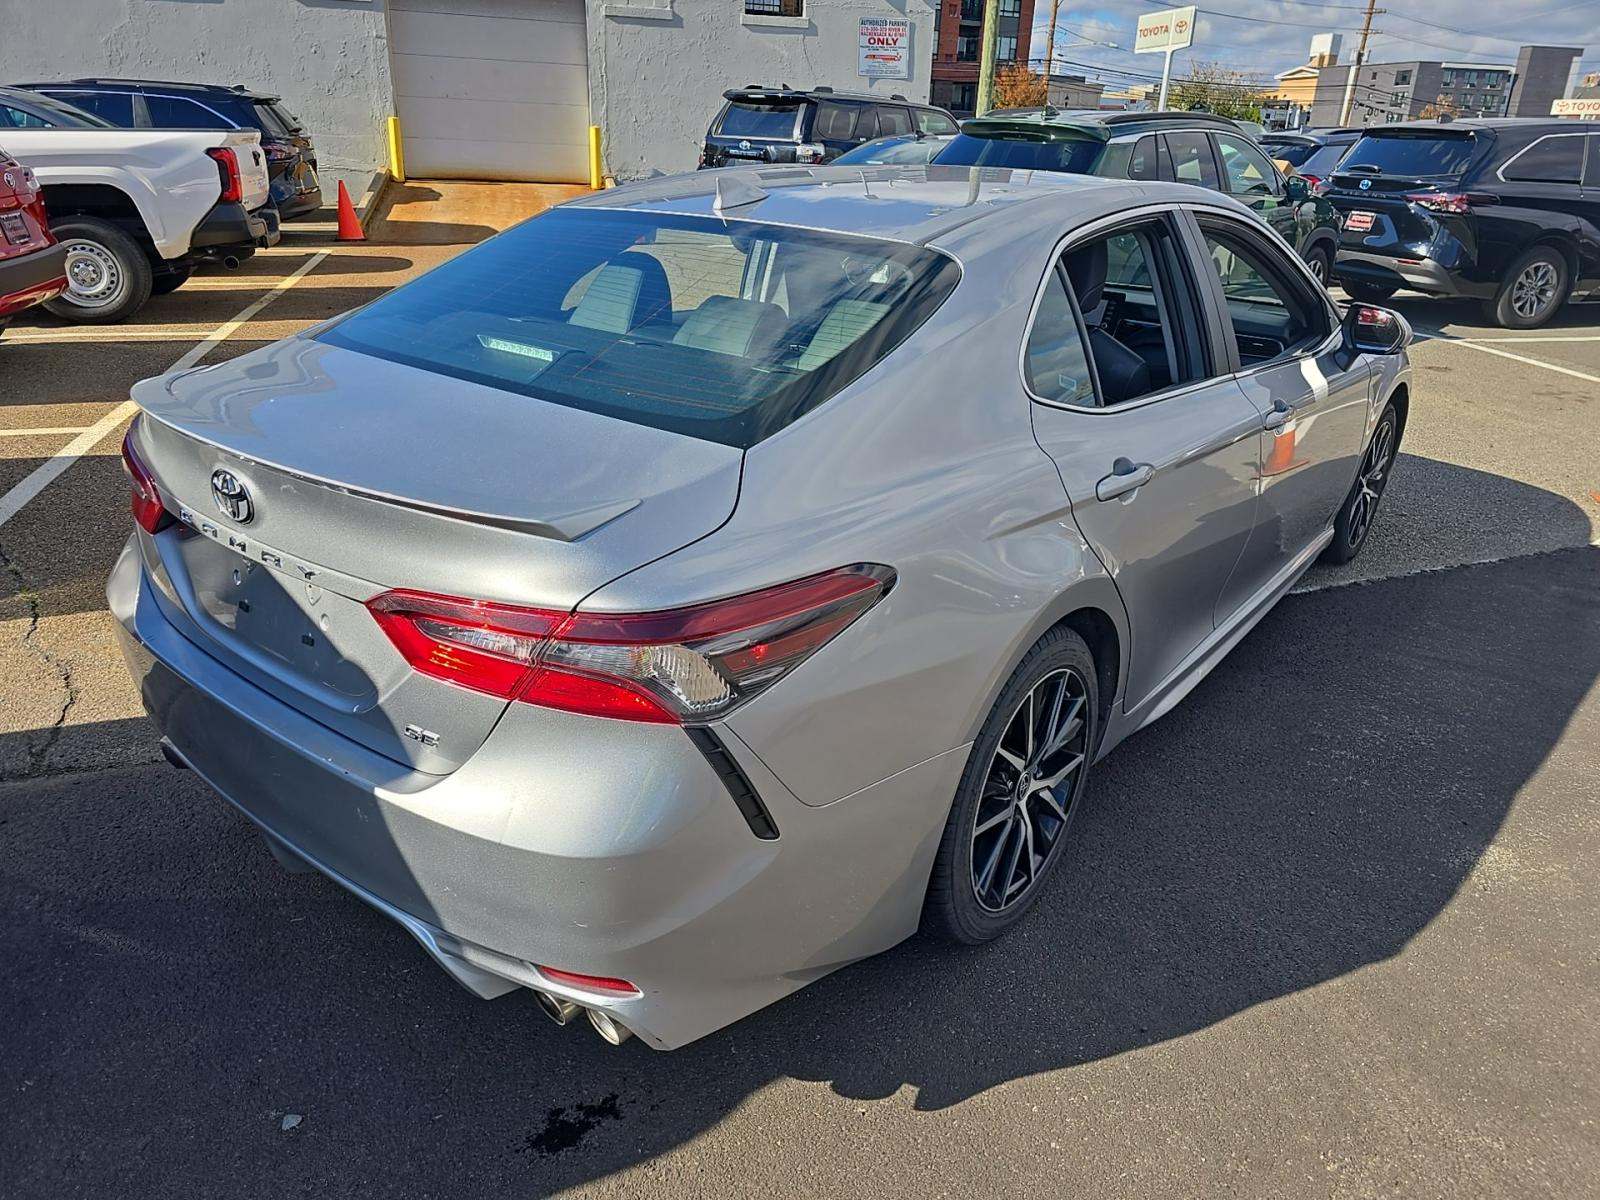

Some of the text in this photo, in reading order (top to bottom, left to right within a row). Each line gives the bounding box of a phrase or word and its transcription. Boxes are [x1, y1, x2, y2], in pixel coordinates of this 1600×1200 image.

[1139, 24, 1169, 38] TOYOTA
[868, 37, 899, 45] ONLY
[179, 508, 321, 581] CAMRY
[404, 723, 440, 747] SE
